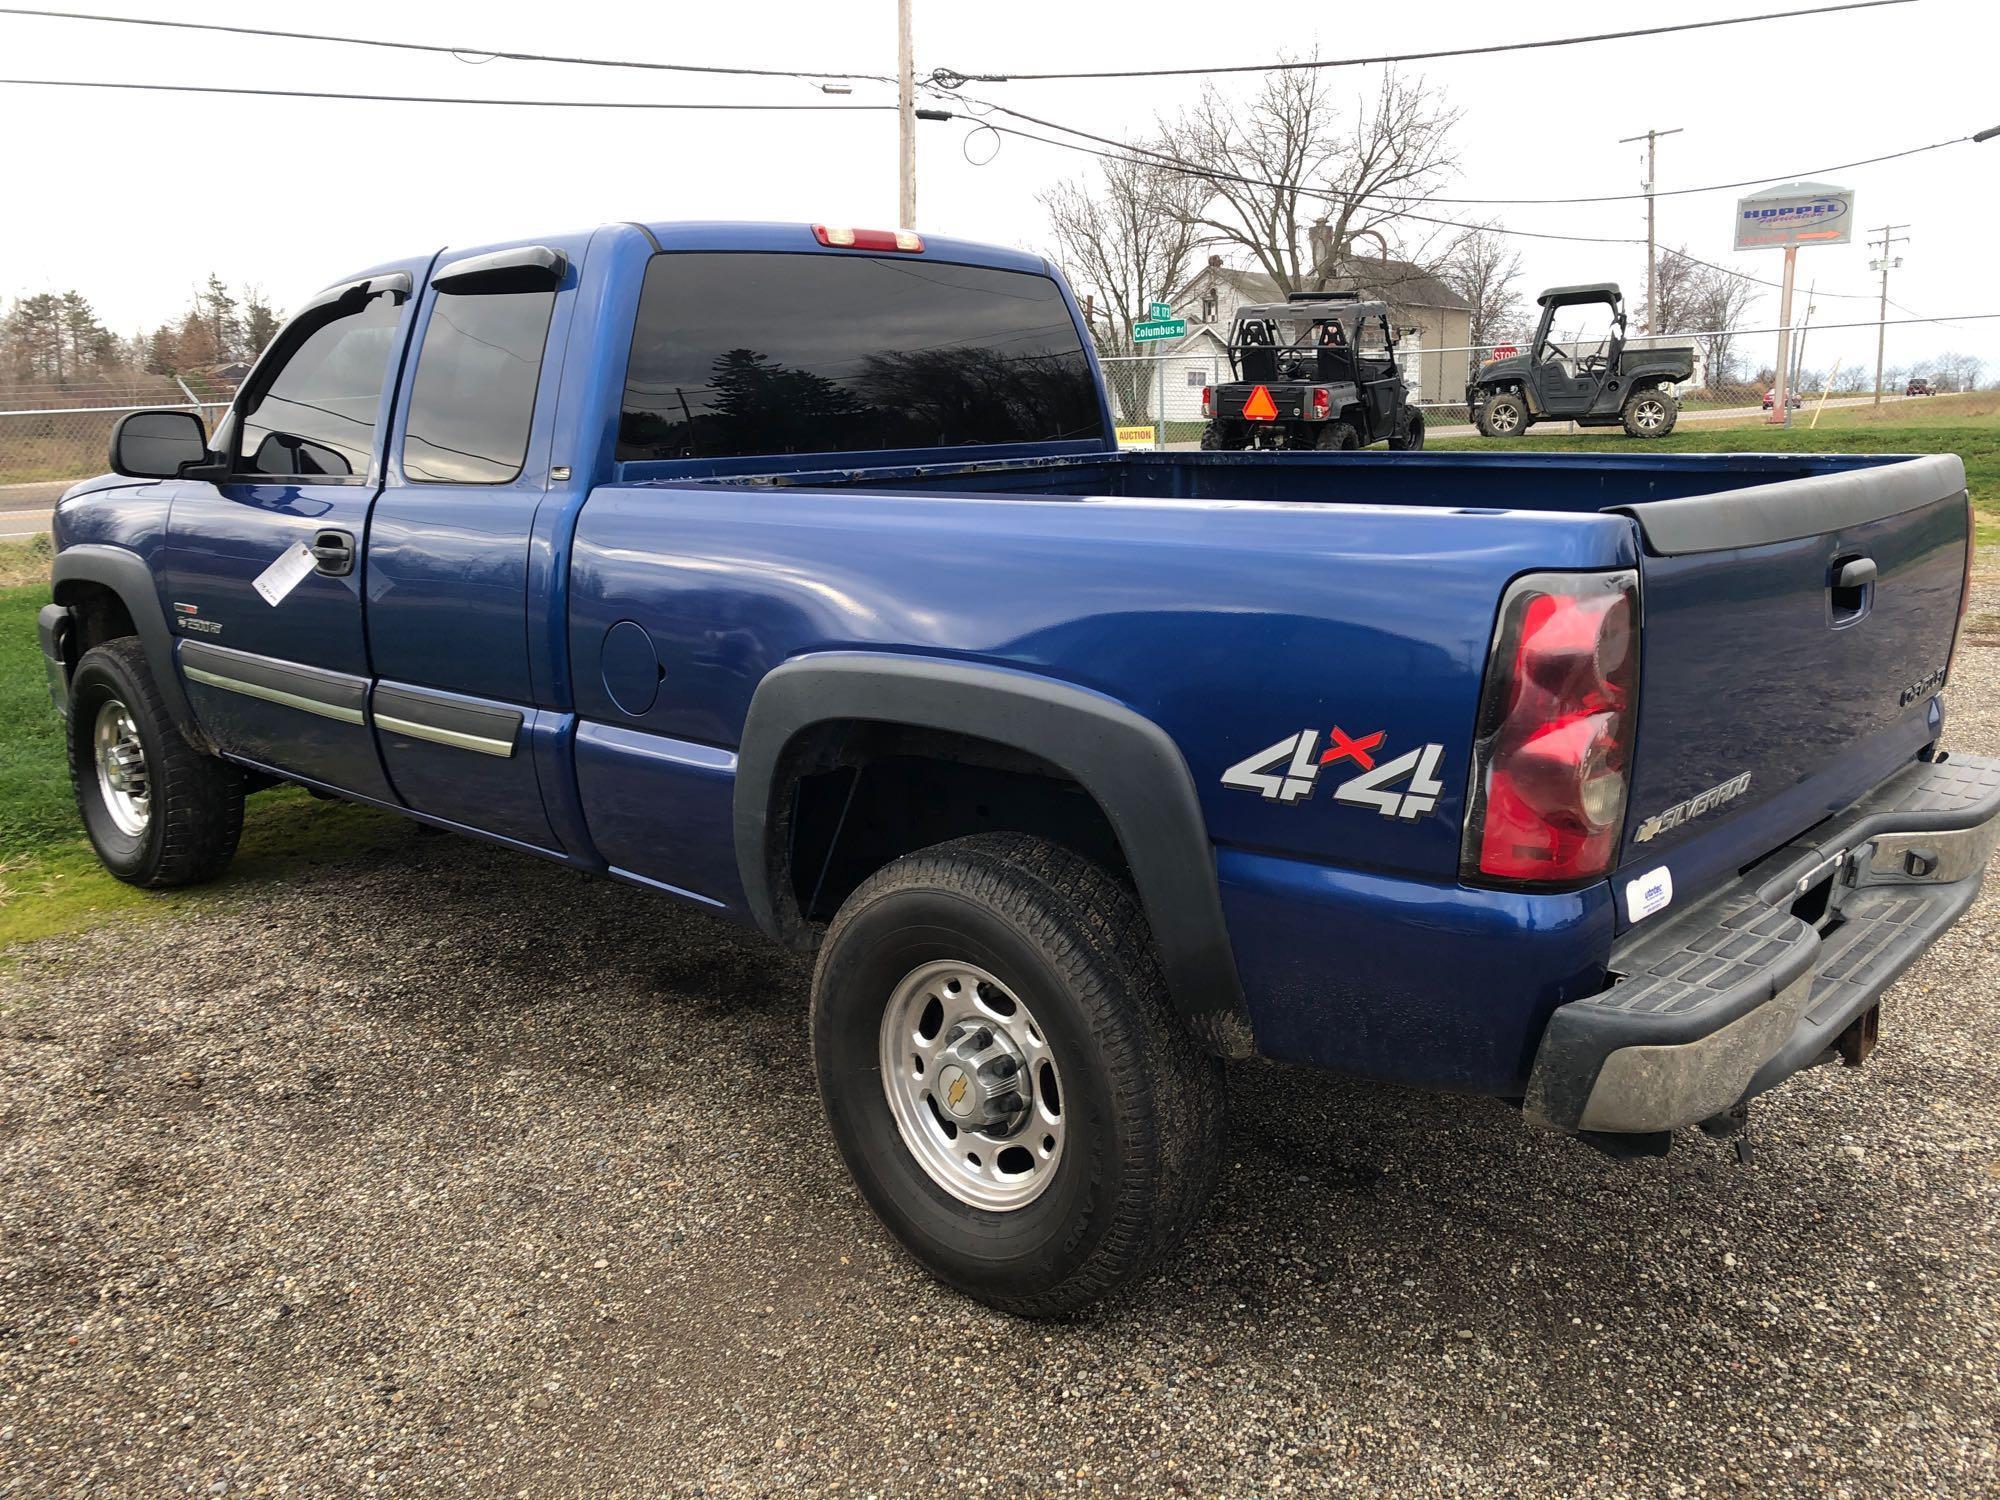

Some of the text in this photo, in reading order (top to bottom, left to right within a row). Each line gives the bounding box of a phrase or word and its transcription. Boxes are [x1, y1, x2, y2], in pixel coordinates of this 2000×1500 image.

[1744, 204, 1839, 218] HOPPEL
[1135, 325, 1184, 338] Columbus Rd
[1119, 430, 1151, 440] AUCTION
[1659, 771, 1752, 833] SILVERADO
